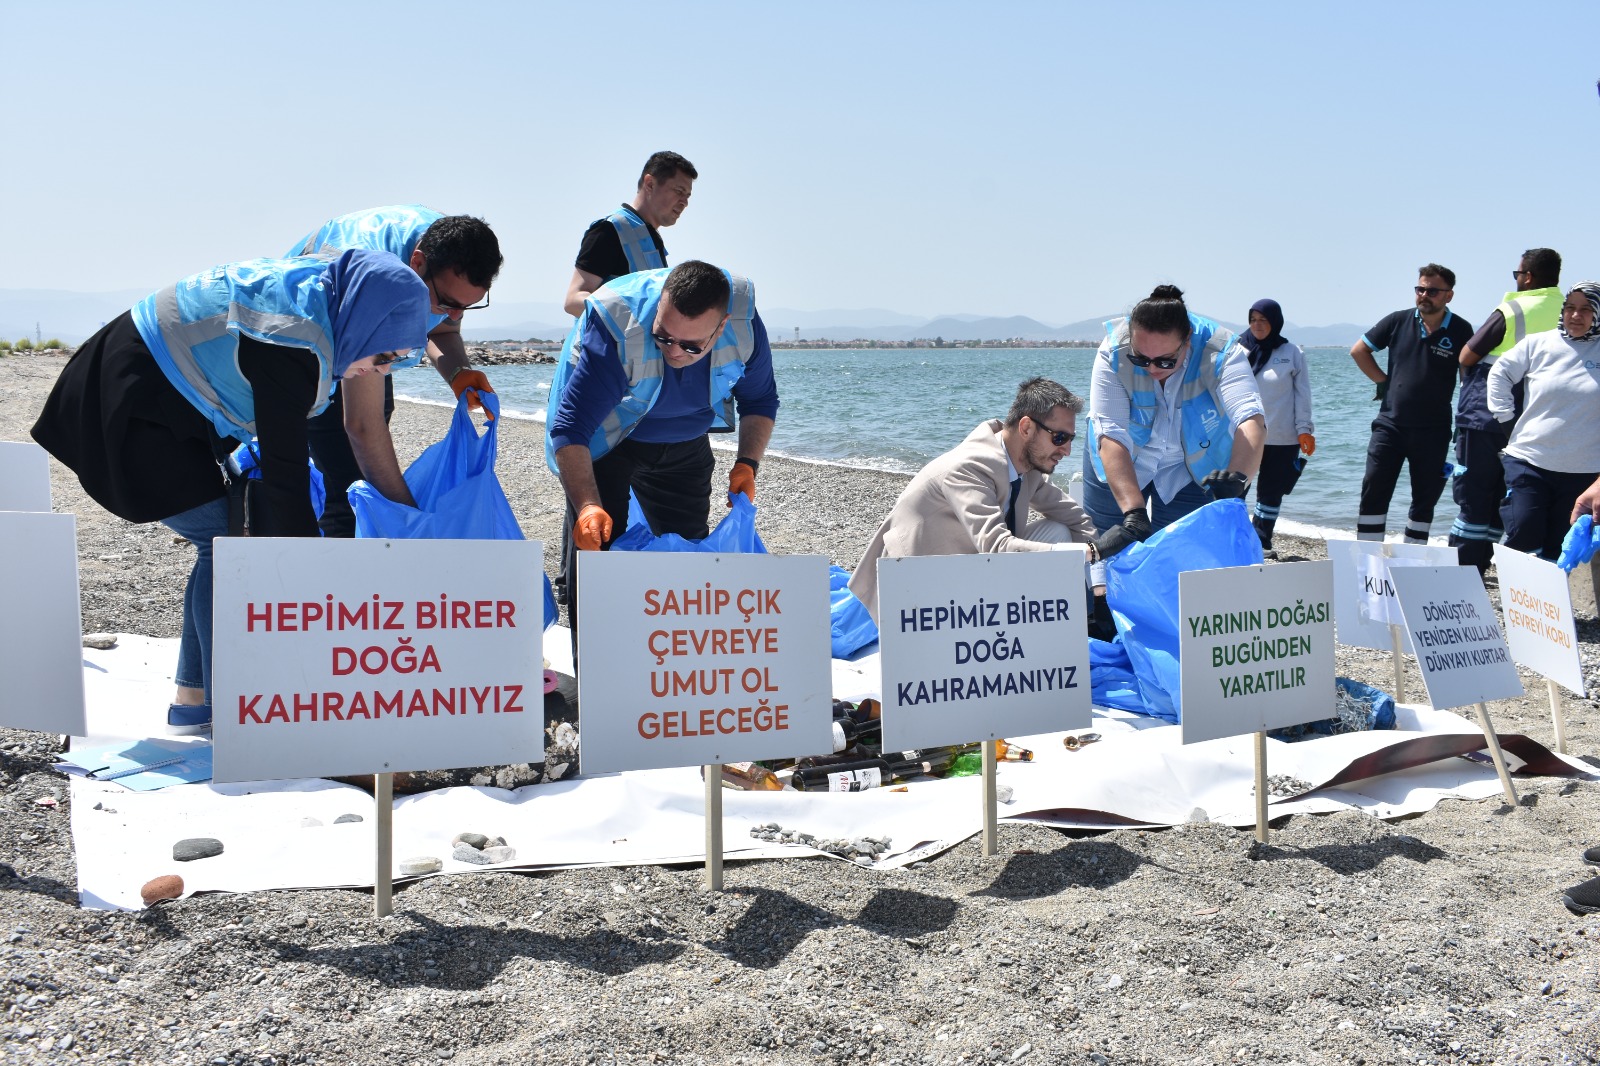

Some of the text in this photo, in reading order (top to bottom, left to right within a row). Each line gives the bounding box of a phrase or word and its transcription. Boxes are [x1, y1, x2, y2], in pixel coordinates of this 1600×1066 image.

[246, 592, 516, 633] HEPİMİZ BİRER
[643, 582, 782, 623] SAHİP ÇIK
[900, 595, 1070, 633] HEPİMİZ BİRER
[1188, 599, 1330, 639] YARININ DOĞASI
[1422, 600, 1480, 624] DÖNÜŞTÜR,
[1510, 587, 1560, 622] DOĞAYI SEV
[647, 628, 779, 665] ÇEVREYE
[1415, 625, 1501, 647] YENİDEN KULLAN
[1509, 608, 1571, 649] ÇEVREYİ KORU
[331, 636, 442, 676] DOĞA
[955, 631, 1025, 664] DOĞA
[1212, 635, 1311, 668] BUGÜNDEN
[1425, 647, 1508, 672] DÜNYAYI KURTAR
[650, 667, 779, 698] UMUT OL
[897, 666, 1078, 706] KAHRAMANIYIZ
[1219, 667, 1306, 699] YARATILIR
[238, 685, 524, 725] KAHRAMANIYIZ
[638, 698, 789, 740] GELECEĞE
